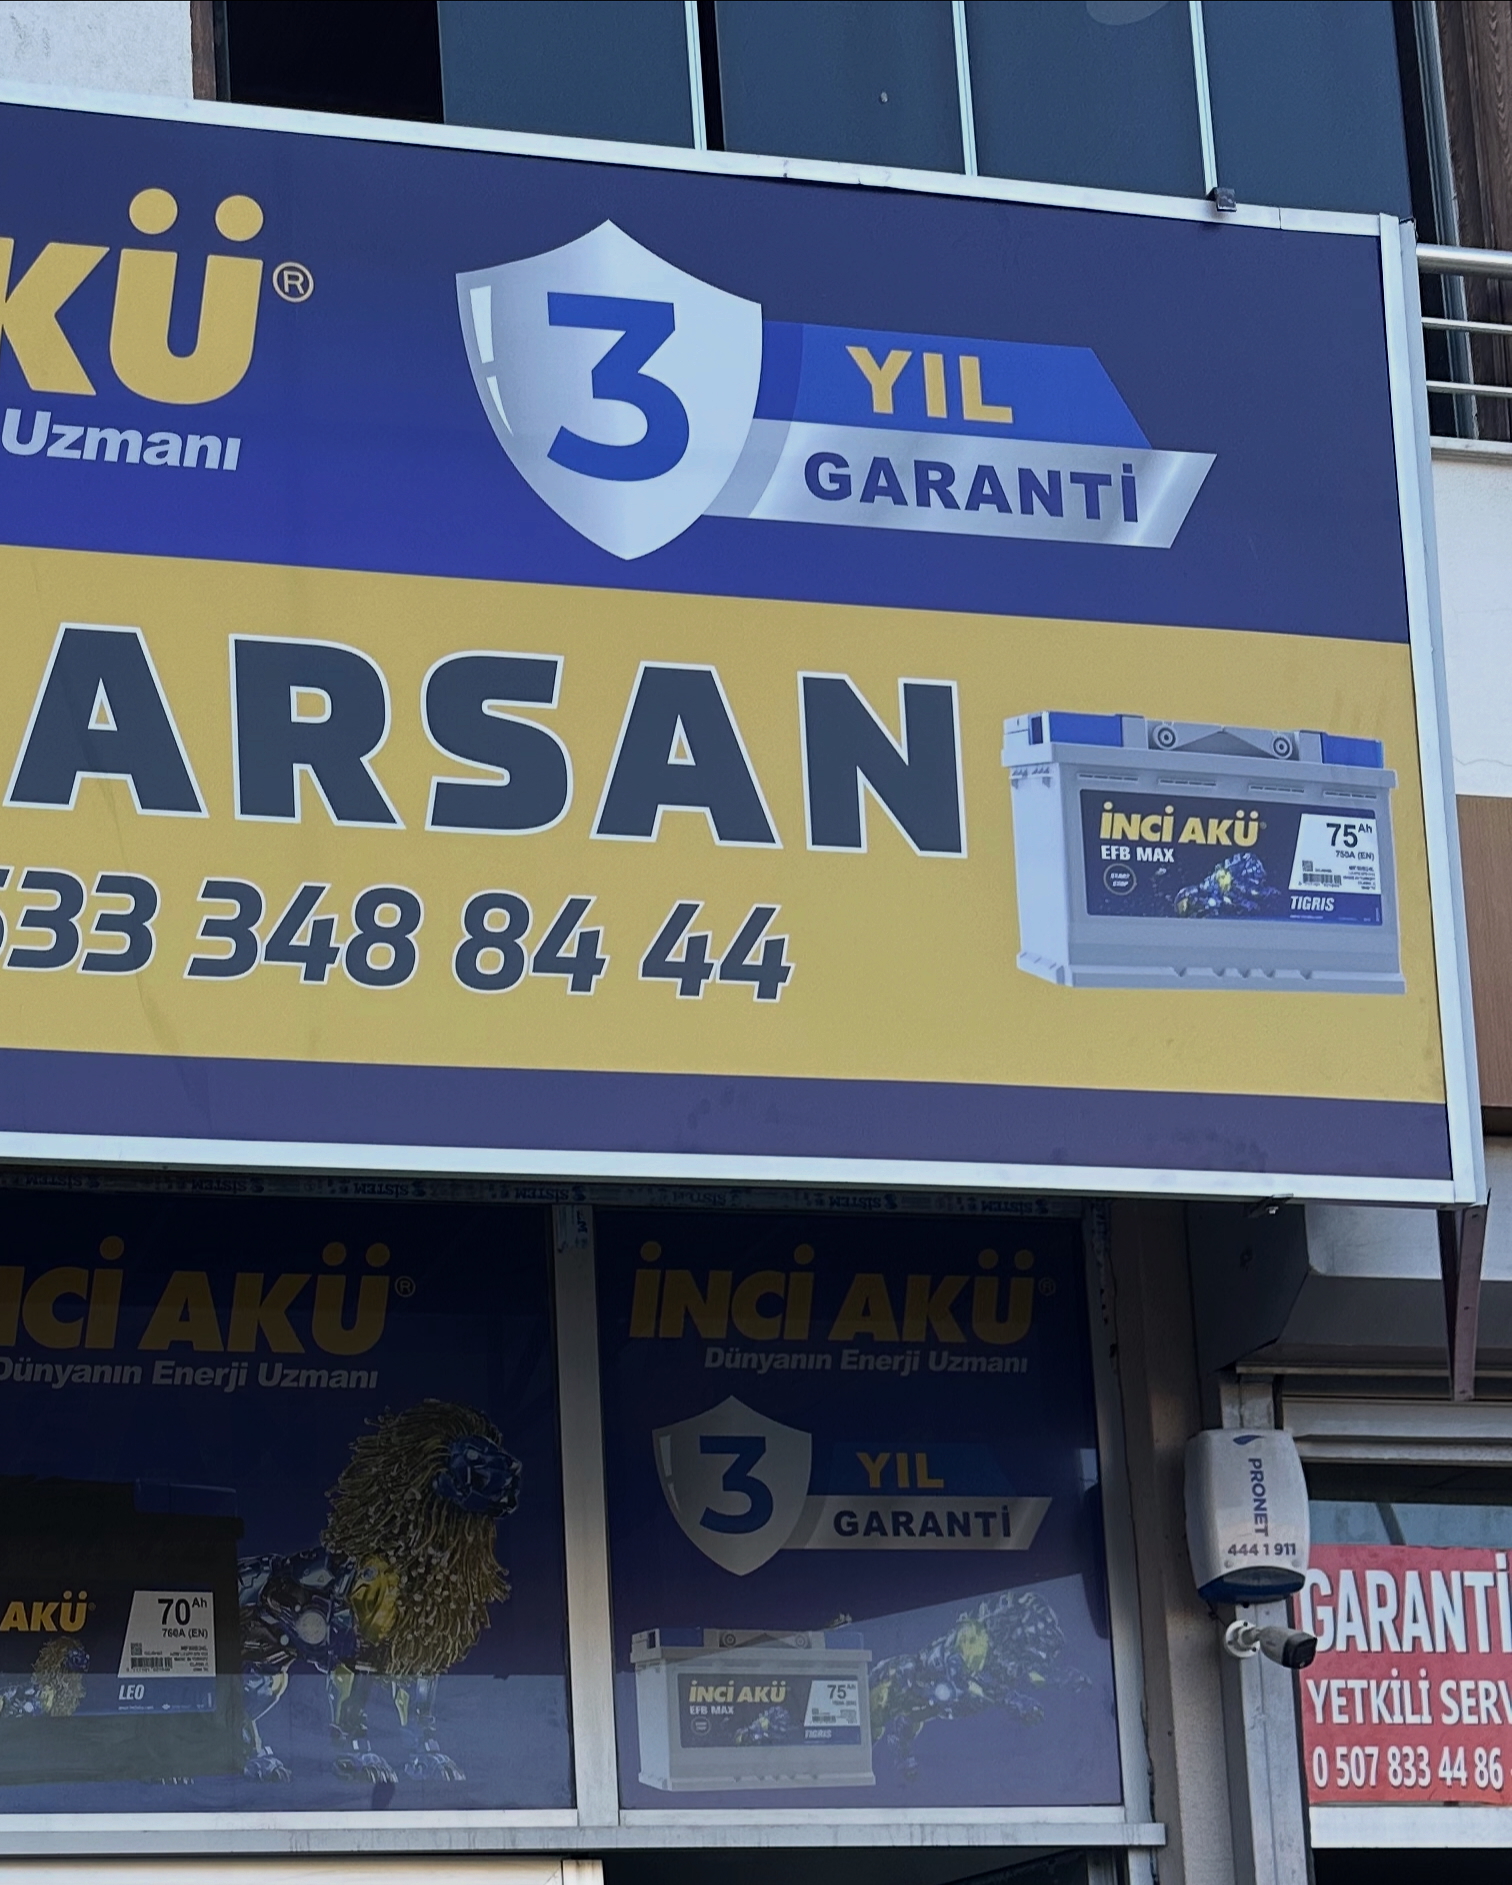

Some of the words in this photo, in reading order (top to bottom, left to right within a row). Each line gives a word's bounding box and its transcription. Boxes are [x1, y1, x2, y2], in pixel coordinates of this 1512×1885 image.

[546, 290, 690, 482] 3
[845, 344, 1013, 424] YIL
[0, 407, 243, 471] Uzmanı
[803, 450, 1141, 524] GARANTİ
[1100, 801, 1175, 843] İNCİ
[1101, 845, 1131, 861] EFB
[1136, 847, 1175, 863] MAX
[1290, 895, 1335, 912] TIGRIS
[183, 877, 423, 991] 348
[452, 890, 609, 995] 84
[638, 899, 794, 1002] 44
[629, 1241, 816, 1341] İNCİ
[151, 1358, 249, 1394] Enerji
[257, 1362, 380, 1389] Uzmanı
[704, 1346, 833, 1375] Dünyanın
[839, 1349, 920, 1377] Enerji
[927, 1351, 1029, 1375] Uzmanı
[699, 1435, 774, 1535] 3
[856, 1452, 945, 1489] YIL
[1248, 1457, 1270, 1538] PRONET
[833, 1505, 1012, 1538] GARANTİ
[1227, 1543, 1261, 1557] 444
[1263, 1543, 1271, 1556] 1
[1273, 1543, 1297, 1557] 911
[162, 1628, 186, 1638] 760A
[118, 1684, 145, 1701] LEO
[688, 1680, 735, 1703] İNCİ
[710, 1705, 735, 1716] MAX
[1305, 1667, 1433, 1724] YETKİLİ
[1312, 1746, 1329, 1788] 0
[1335, 1746, 1379, 1787] 507
[1387, 1746, 1432, 1788] 833
[1437, 1746, 1468, 1787] 44
[1473, 1747, 1504, 1790] 86
